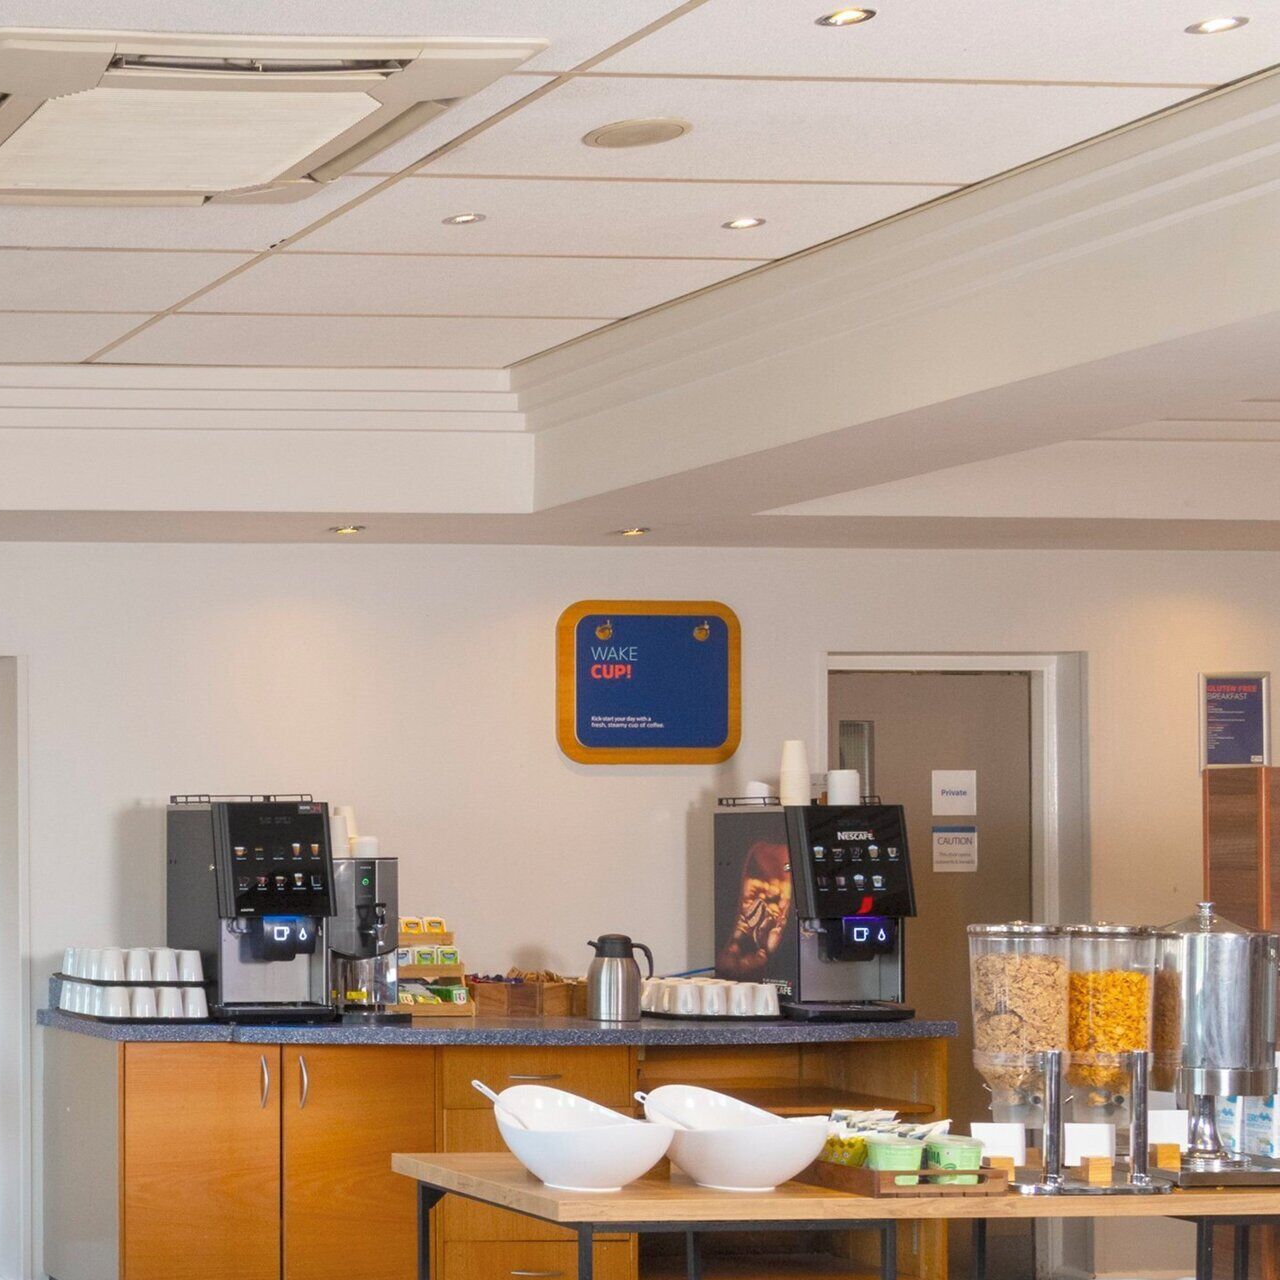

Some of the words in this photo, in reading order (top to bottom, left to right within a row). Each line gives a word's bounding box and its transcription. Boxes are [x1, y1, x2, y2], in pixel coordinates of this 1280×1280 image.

[591, 646, 638, 661] WAKE
[591, 663, 632, 679] CUP!
[1207, 692, 1248, 700] BREAKFAST
[937, 836, 973, 846] CAUTION
